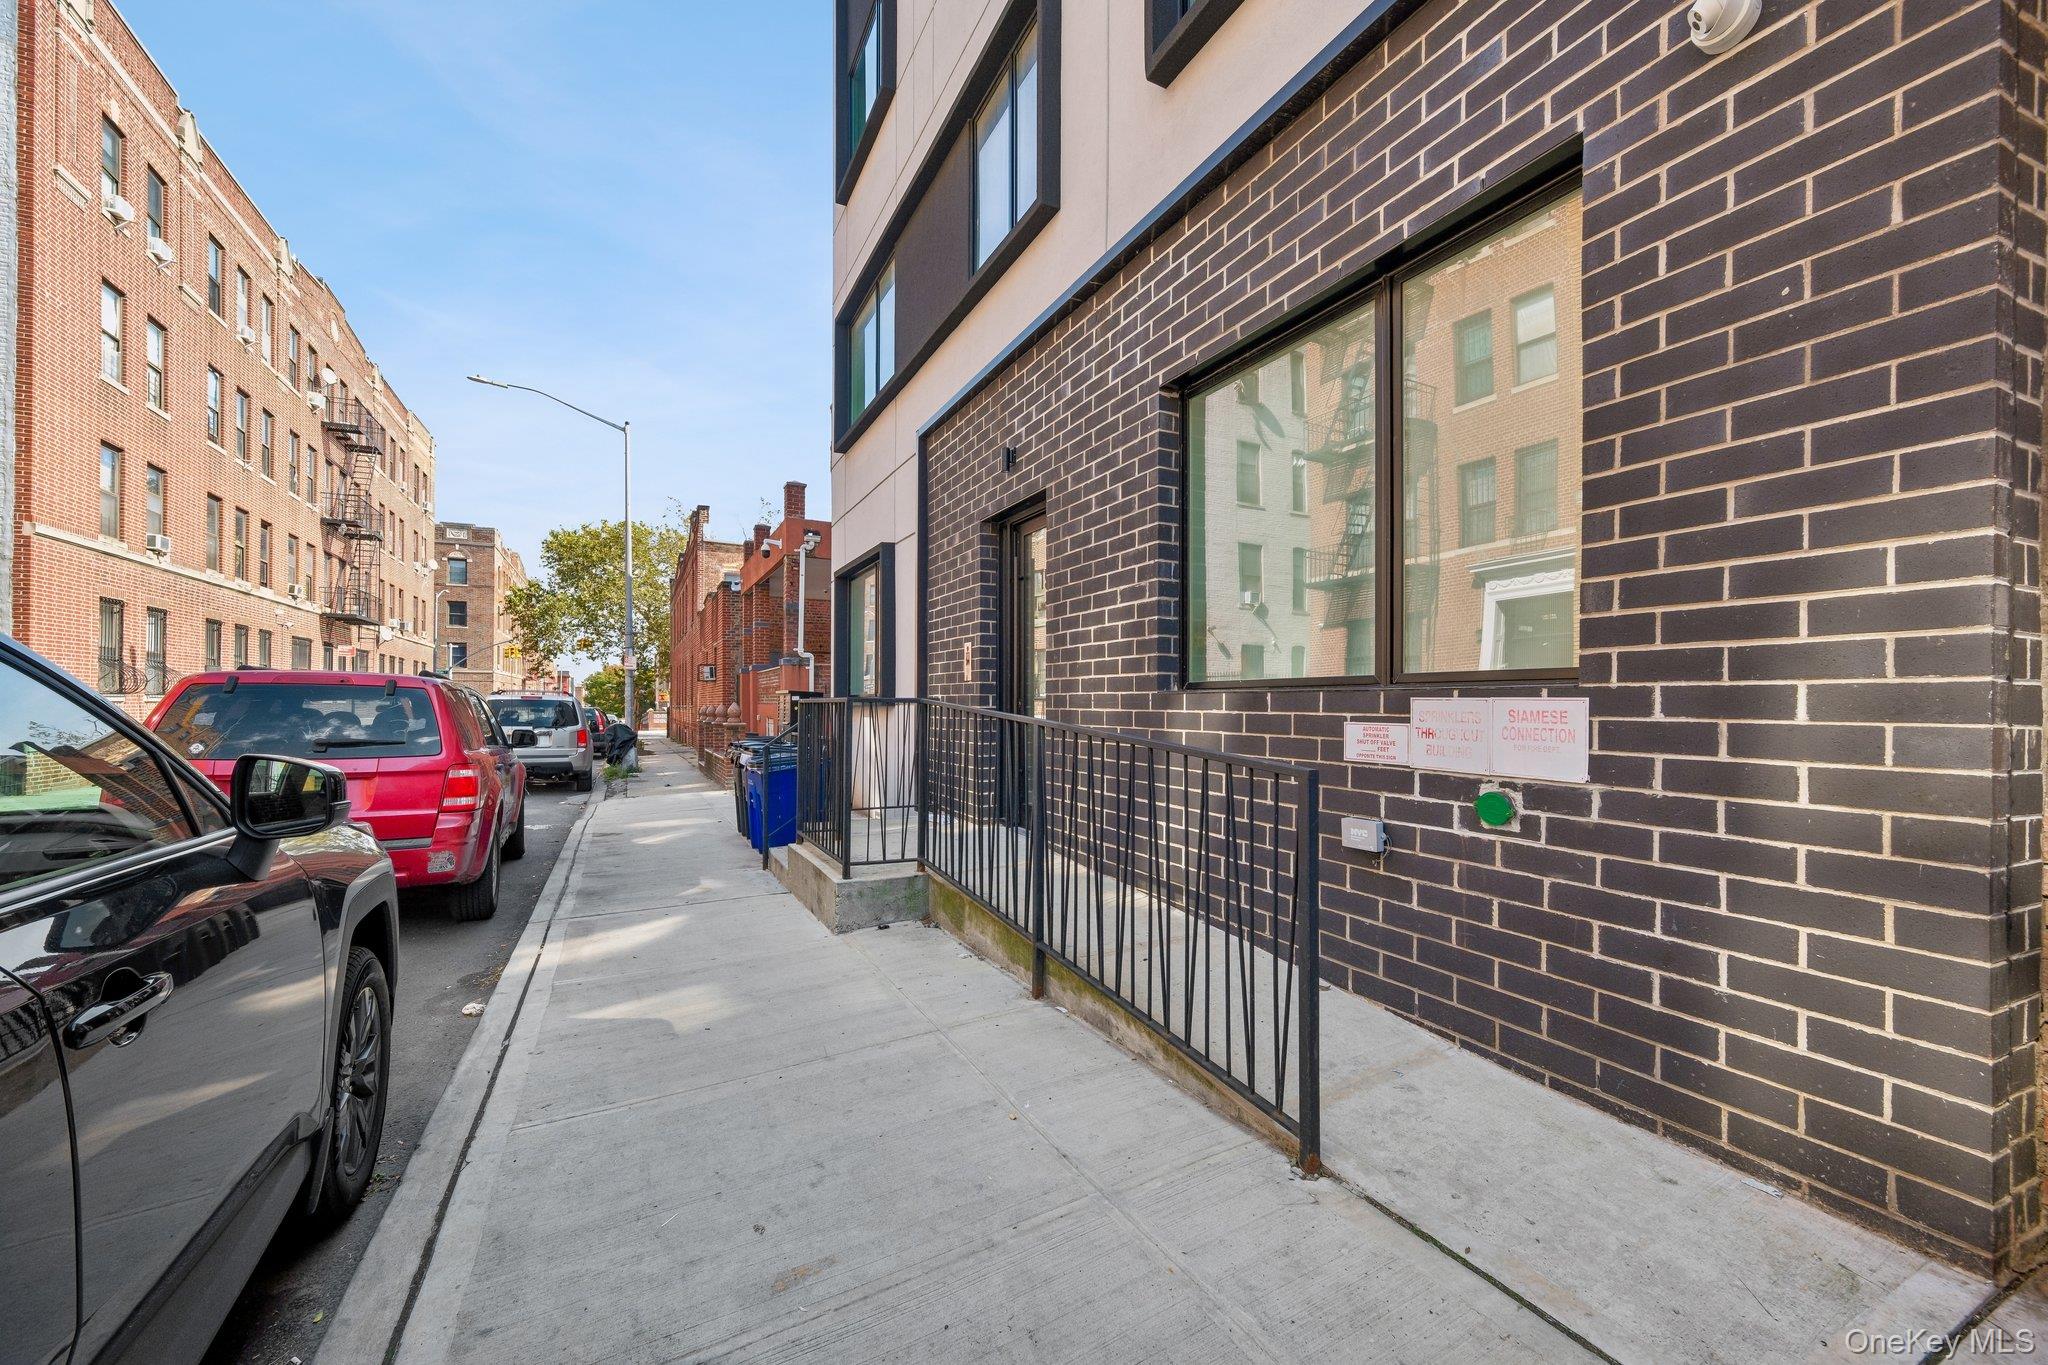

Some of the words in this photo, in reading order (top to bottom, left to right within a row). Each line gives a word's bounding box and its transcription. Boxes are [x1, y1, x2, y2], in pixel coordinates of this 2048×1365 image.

[1508, 709, 1569, 725] SIAMESE
[1501, 726, 1576, 744] CONNECTION
[1350, 828, 1369, 838] NYC
